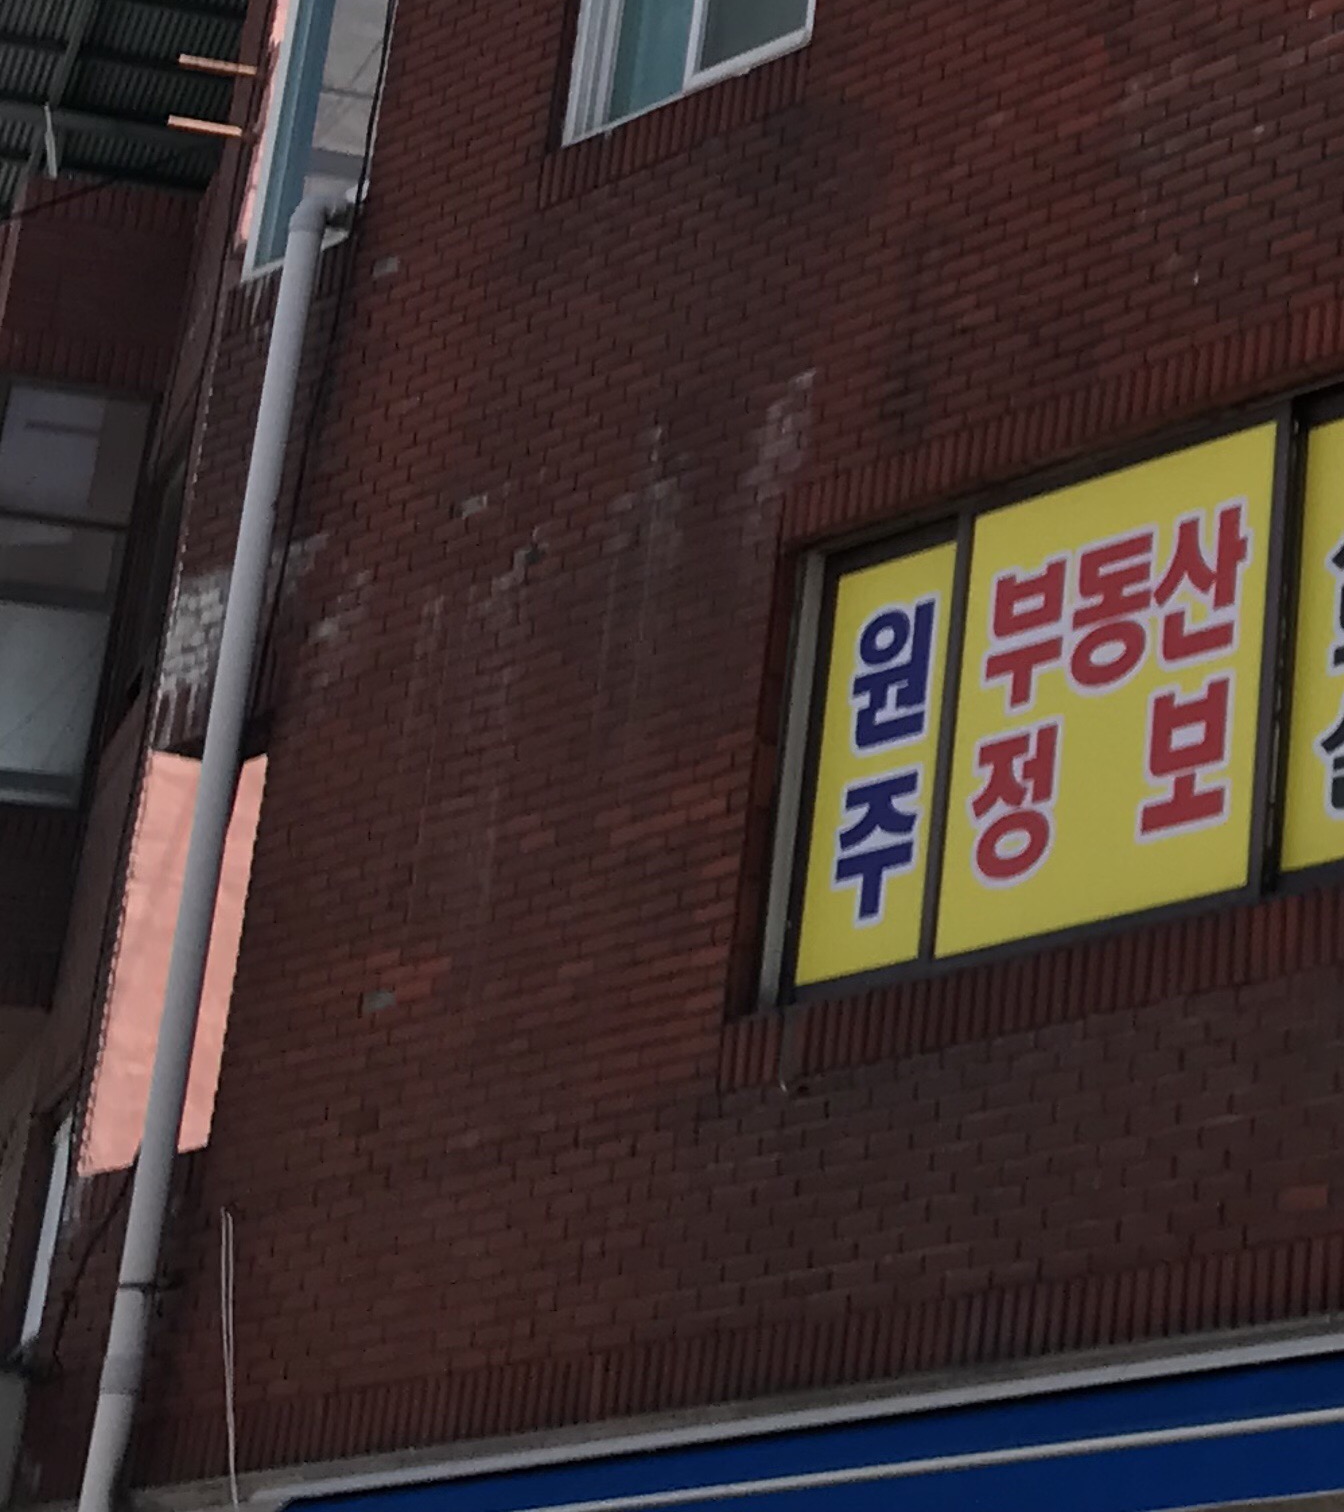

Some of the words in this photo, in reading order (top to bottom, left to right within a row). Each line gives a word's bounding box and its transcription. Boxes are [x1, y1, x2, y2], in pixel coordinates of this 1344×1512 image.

[984, 502, 1250, 711] 부동산
[834, 600, 936, 923] 원주
[970, 676, 1232, 884] 정보
